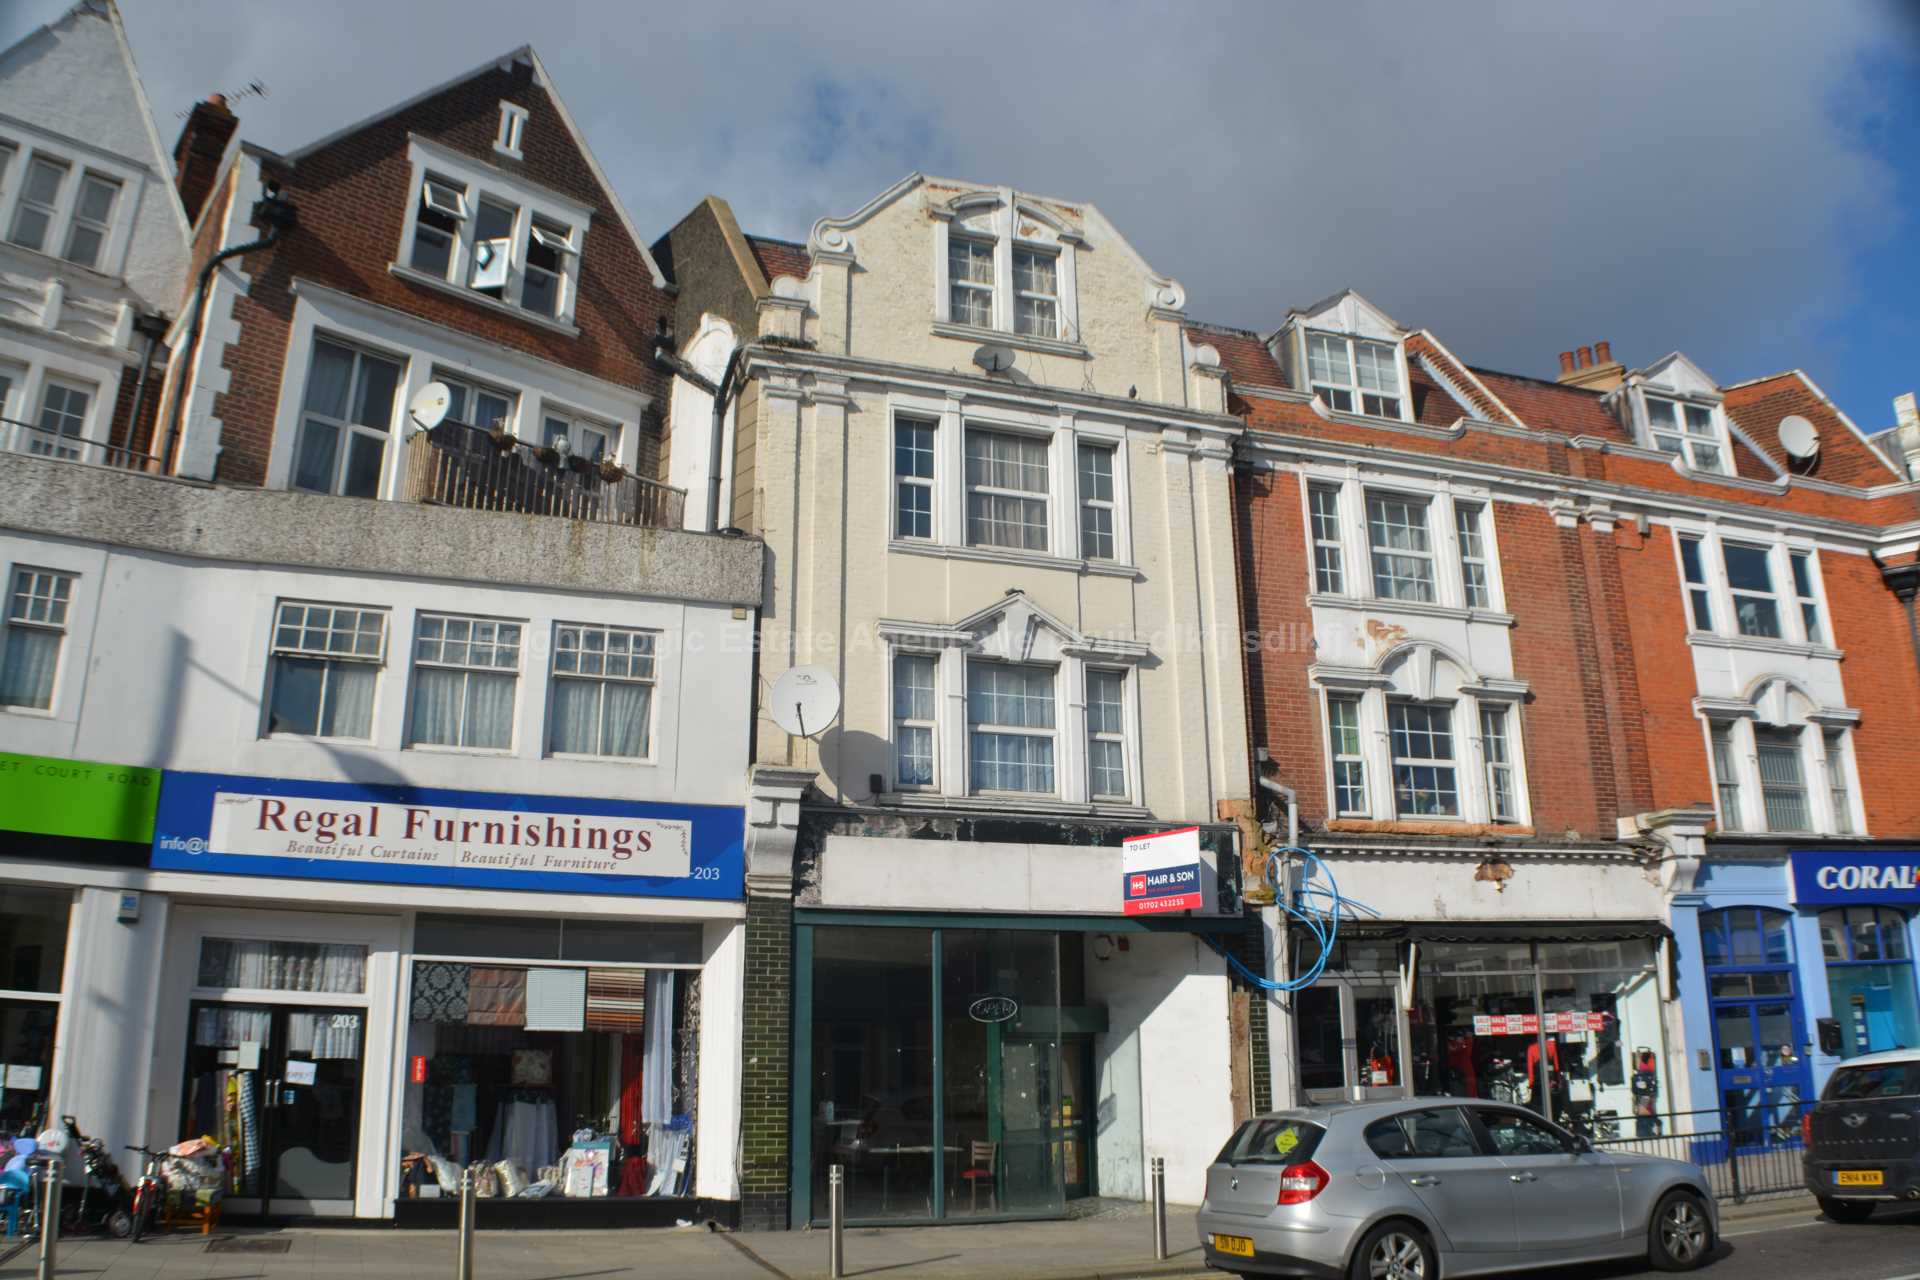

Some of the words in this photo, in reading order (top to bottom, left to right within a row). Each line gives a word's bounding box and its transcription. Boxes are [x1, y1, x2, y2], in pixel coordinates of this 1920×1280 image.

[34, 764, 92, 780] COURT
[107, 772, 151, 787] ROAD
[256, 798, 380, 843] Regal
[403, 808, 652, 860] Furnishings
[286, 840, 363, 859] Beautiful
[370, 844, 439, 861] Curtains
[460, 851, 535, 869] Beautiful
[544, 855, 617, 871] Furniture
[1139, 842, 1151, 850] LET
[1147, 874, 1168, 886] HAIR
[1169, 873, 1175, 883] &
[1177, 871, 1195, 881] SON
[1817, 865, 1916, 890] CORAL
[1139, 901, 1158, 910] 01702
[332, 1014, 358, 1029] 203
